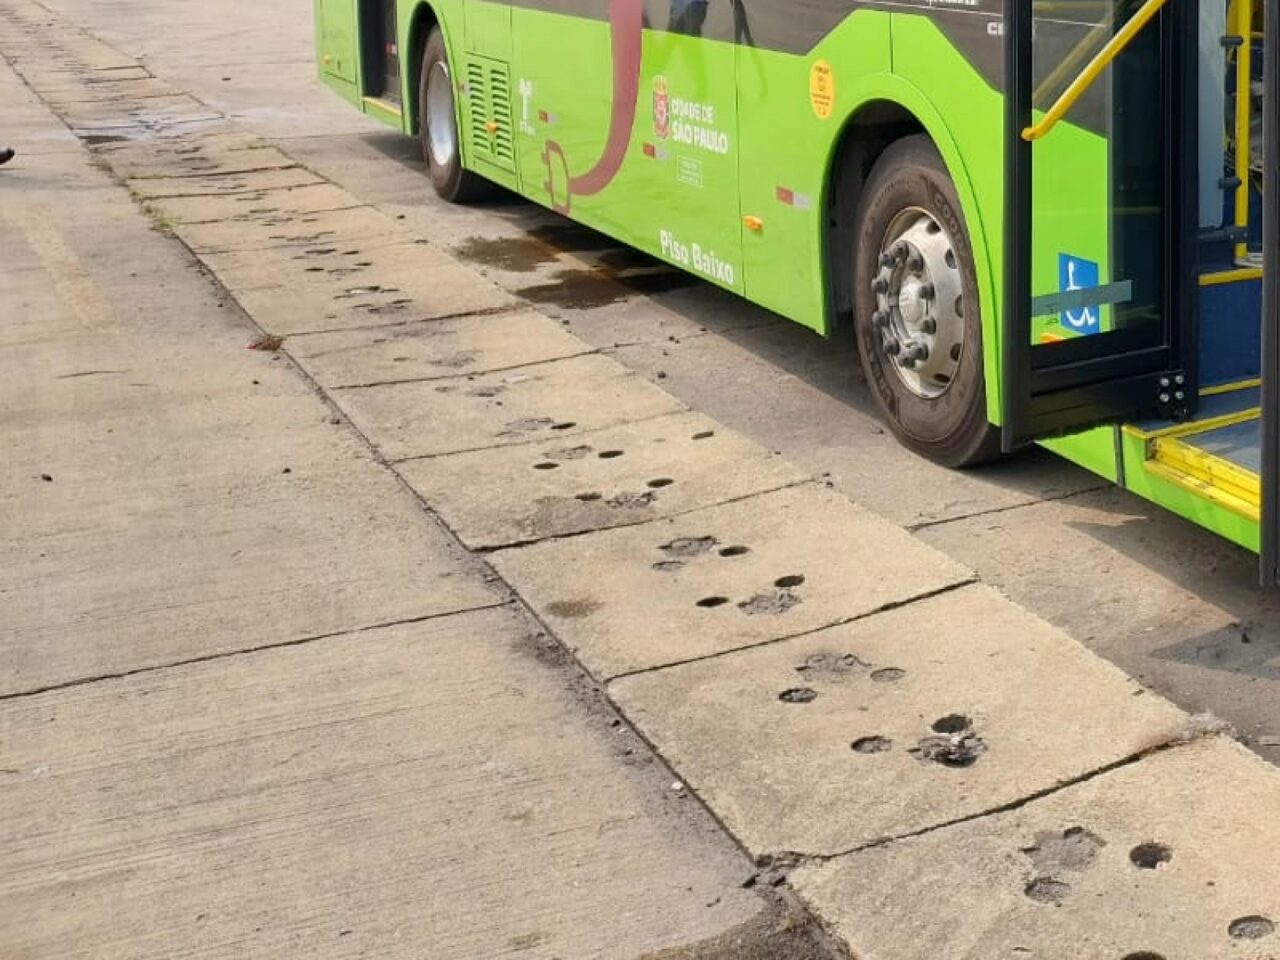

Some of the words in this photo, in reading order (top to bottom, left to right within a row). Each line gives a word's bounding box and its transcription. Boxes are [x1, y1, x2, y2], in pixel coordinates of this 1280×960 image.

[672, 118, 692, 145] SÃO
[693, 126, 729, 155] PAULO
[660, 230, 689, 265] Piso
[692, 242, 734, 286] Baixo
